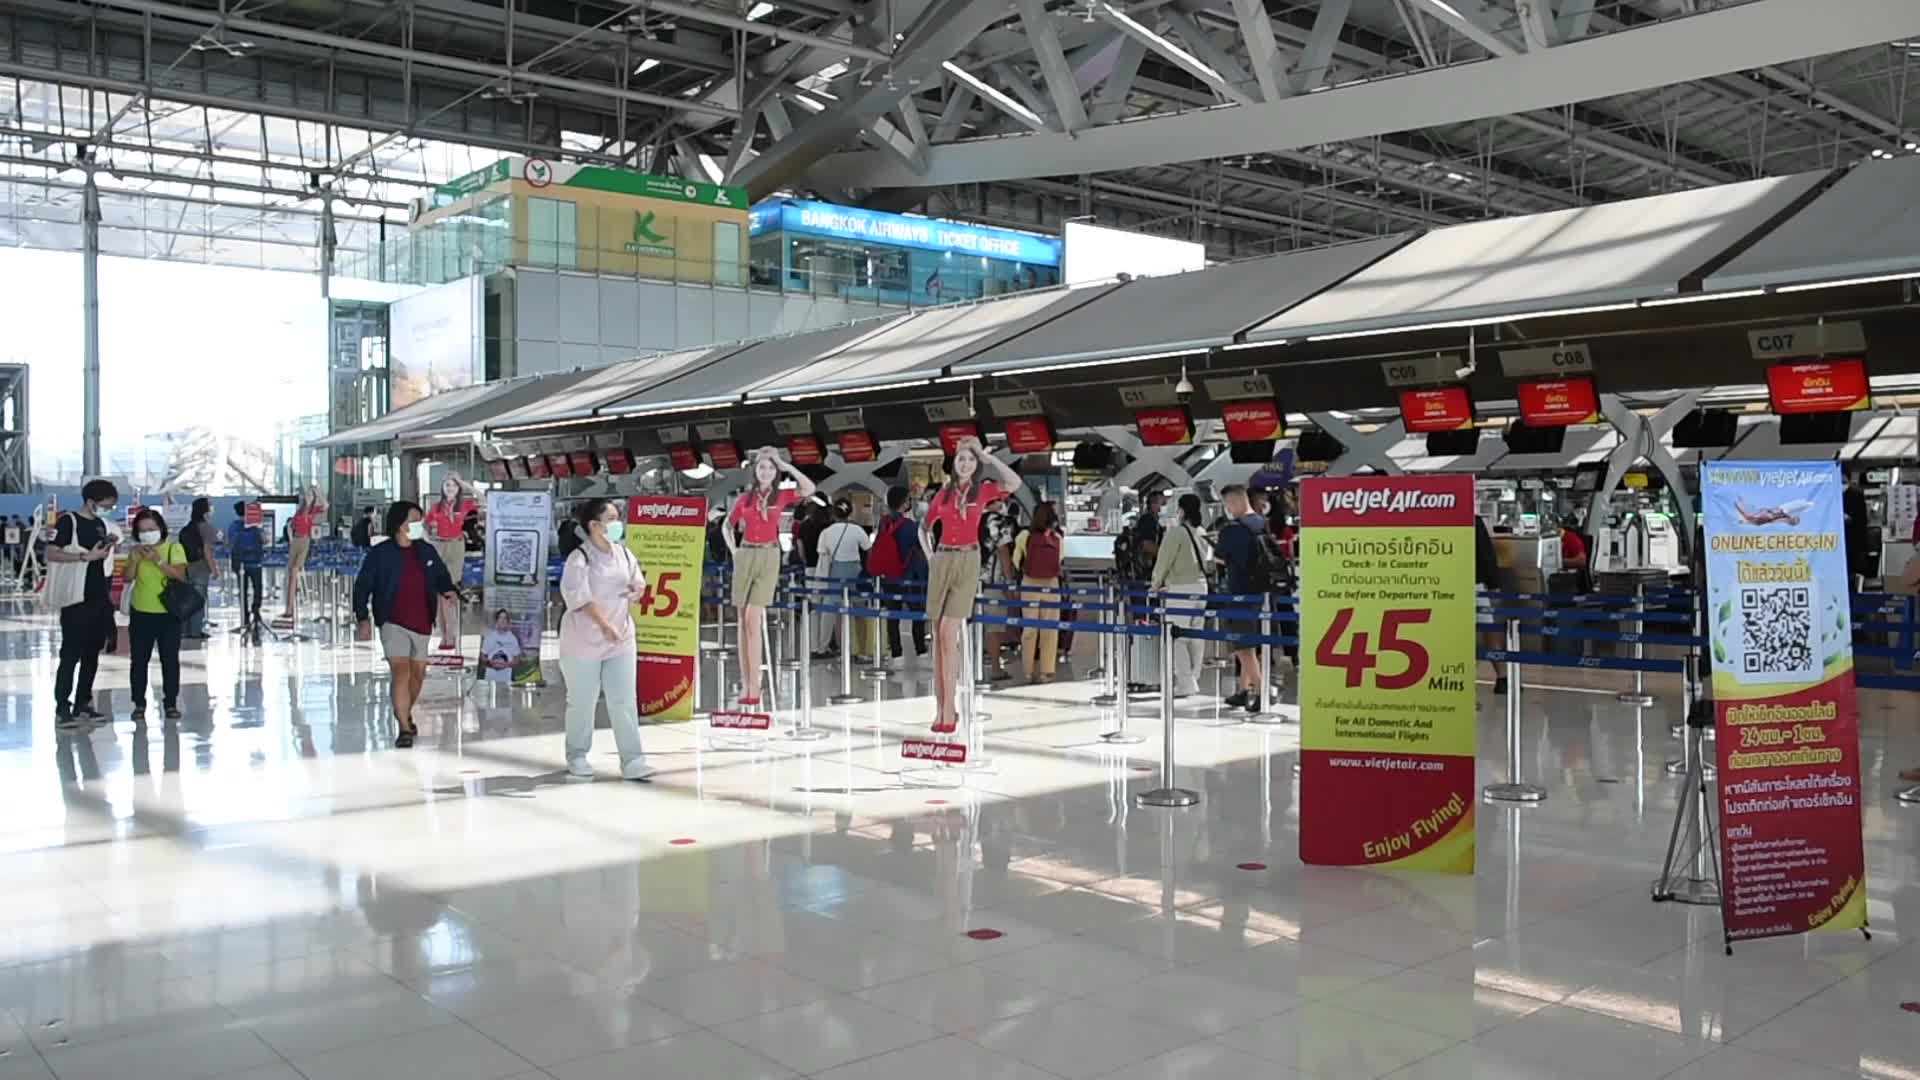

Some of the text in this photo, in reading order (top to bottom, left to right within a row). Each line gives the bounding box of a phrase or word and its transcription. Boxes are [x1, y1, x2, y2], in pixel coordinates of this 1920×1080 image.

[801, 208, 1022, 256] BANGKOK AIRWAYS TICKET OFFICE
[1757, 335, 1793, 351] C07
[1551, 350, 1585, 367] C08
[1389, 366, 1417, 379] C09
[1241, 379, 1269, 392] C10
[1316, 536, 1454, 555] เคาน์เตอร์เช็คอิน
[1711, 535, 1764, 551] ONLINE
[1390, 560, 1429, 569] Counter
[1317, 590, 1455, 600] Close before Departure Time
[1315, 608, 1432, 690] 45
[1441, 662, 1465, 675] นาที
[1579, 656, 1602, 666] AOT
[1428, 677, 1465, 692] Mins
[1336, 717, 1433, 729] For All Domestic And
[1335, 730, 1430, 742] International Flights
[1329, 757, 1444, 772] www.vietjetair.com
[1363, 792, 1465, 859] Enjoy Flying!
